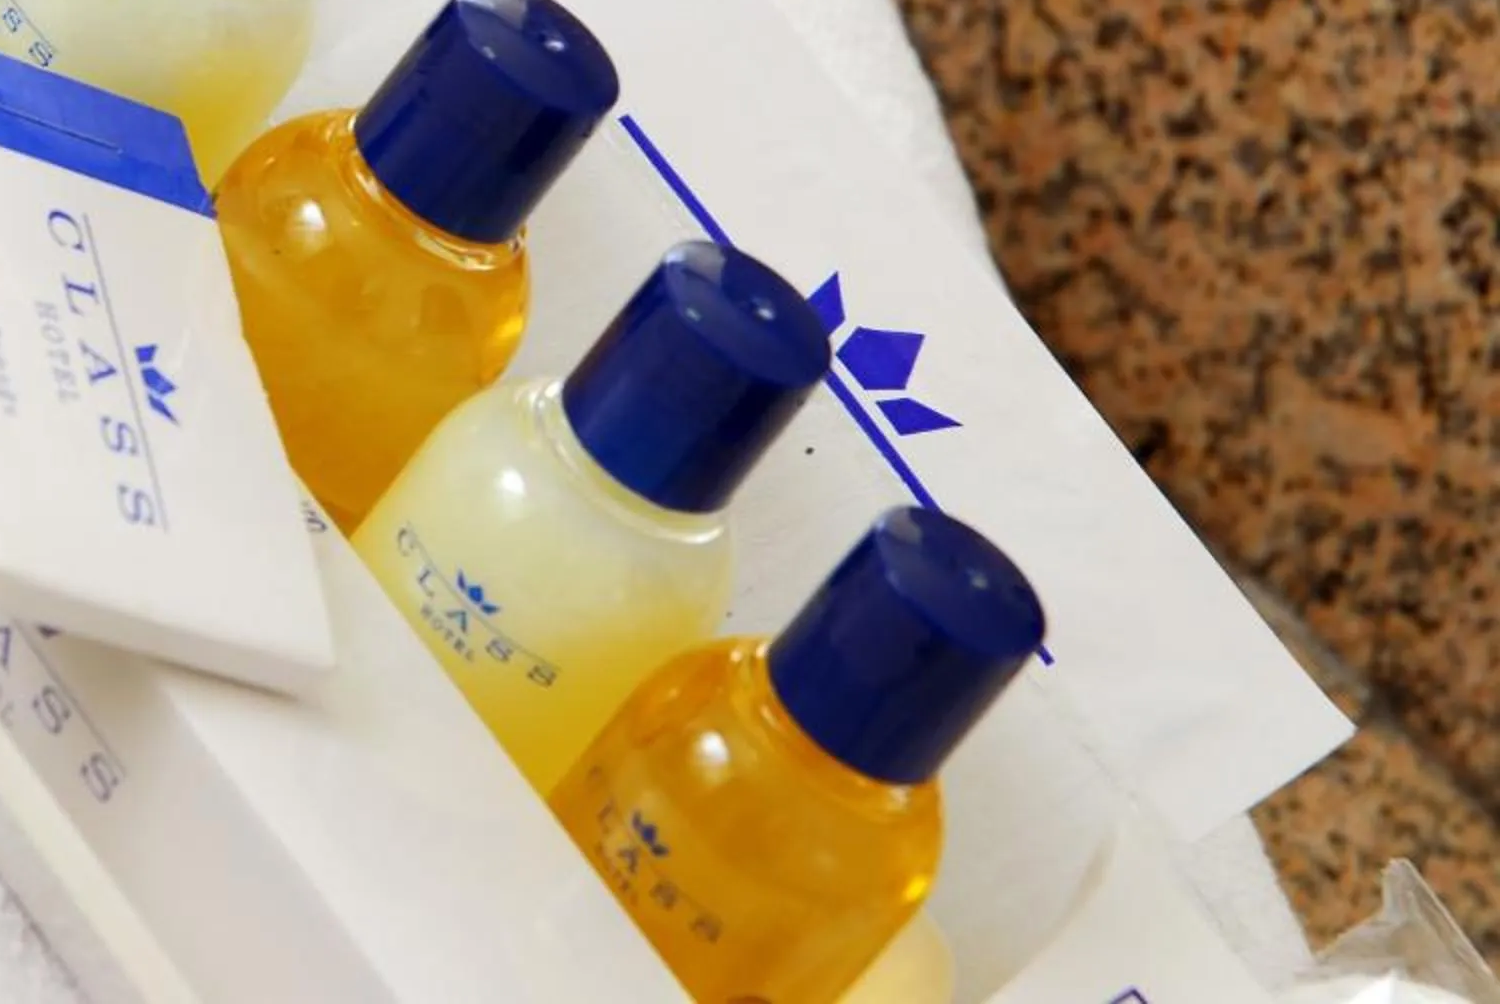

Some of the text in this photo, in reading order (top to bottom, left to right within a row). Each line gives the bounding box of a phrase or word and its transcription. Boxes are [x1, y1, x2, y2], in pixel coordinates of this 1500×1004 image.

[35, 299, 80, 404] HOTEL
[48, 209, 156, 527] CLASS
[397, 528, 557, 688] CLASS
